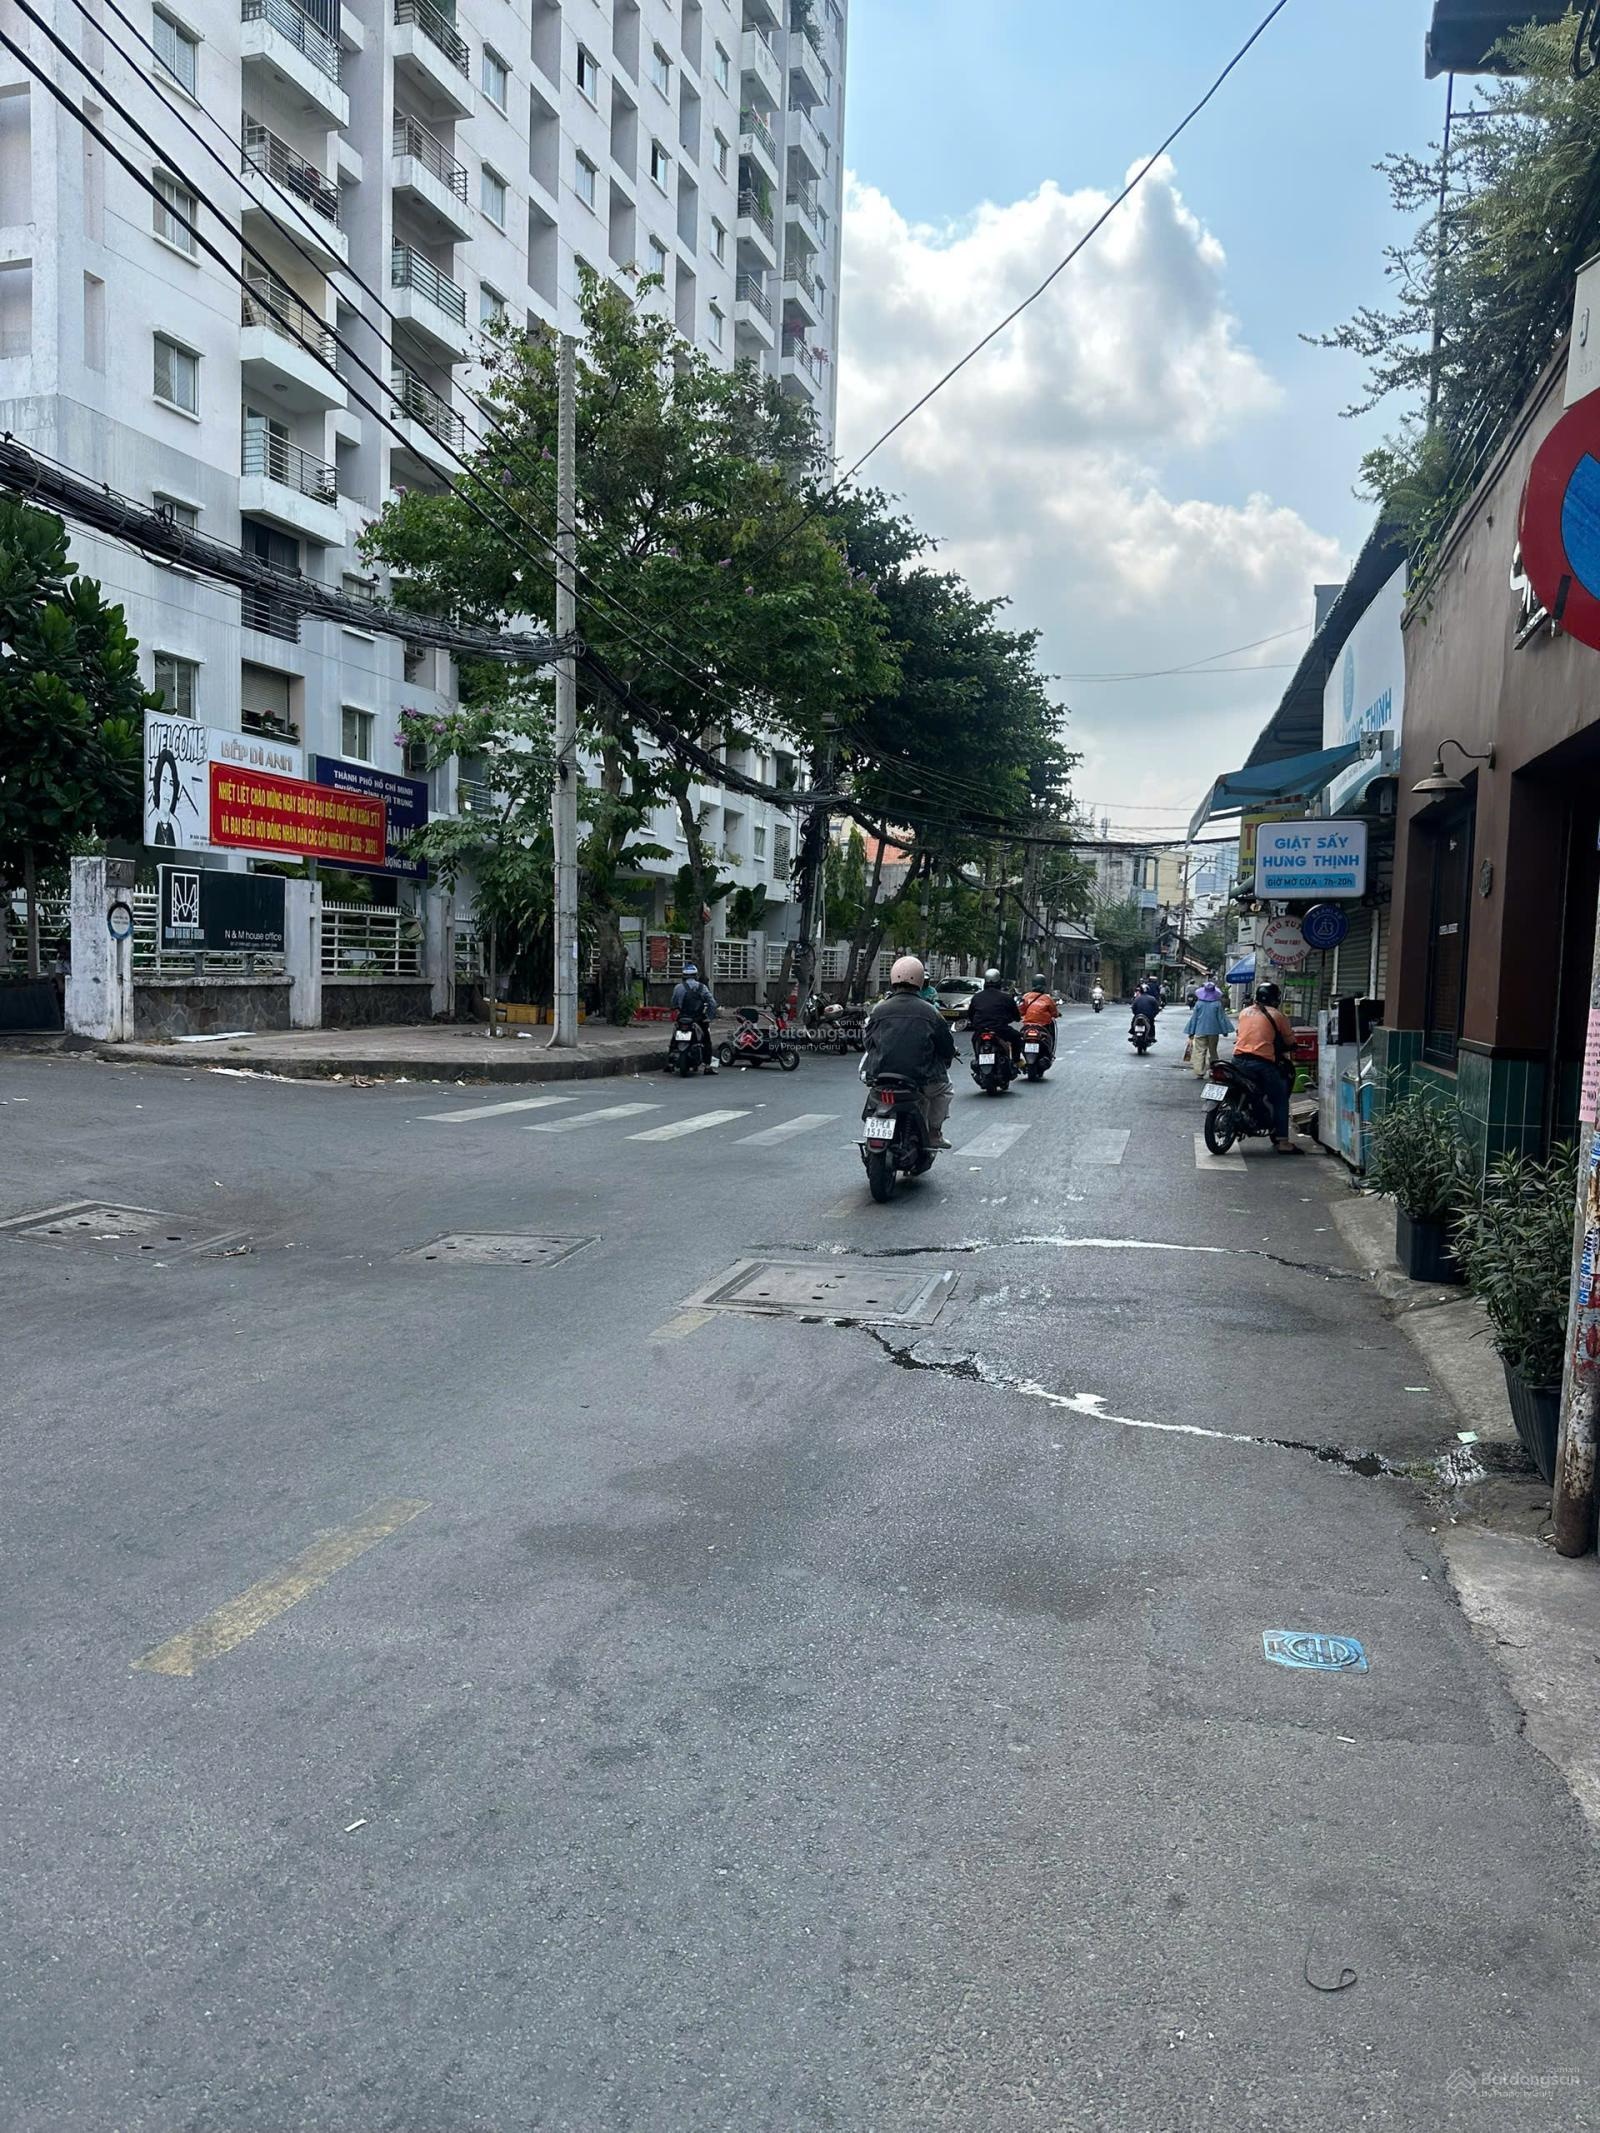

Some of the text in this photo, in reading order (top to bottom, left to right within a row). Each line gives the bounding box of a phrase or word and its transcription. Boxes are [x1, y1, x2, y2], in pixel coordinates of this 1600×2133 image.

[221, 739, 248, 761] BẾP
[218, 778, 236, 805] NHIỆT
[237, 781, 250, 807] LIỆT
[250, 784, 265, 807] CHÀO
[334, 769, 357, 783] THÀNH
[358, 775, 373, 786] PHỐ
[374, 778, 383, 790] HỒ
[385, 781, 396, 791] CHÍ
[397, 785, 413, 796] MINH
[221, 811, 230, 834] VÀ
[1316, 832, 1349, 849] SẤY
[1312, 854, 1360, 869] THỊNH
[224, 929, 230, 939] N
[231, 929, 237, 939] &
[238, 930, 244, 940] M
[245, 930, 264, 940] house
